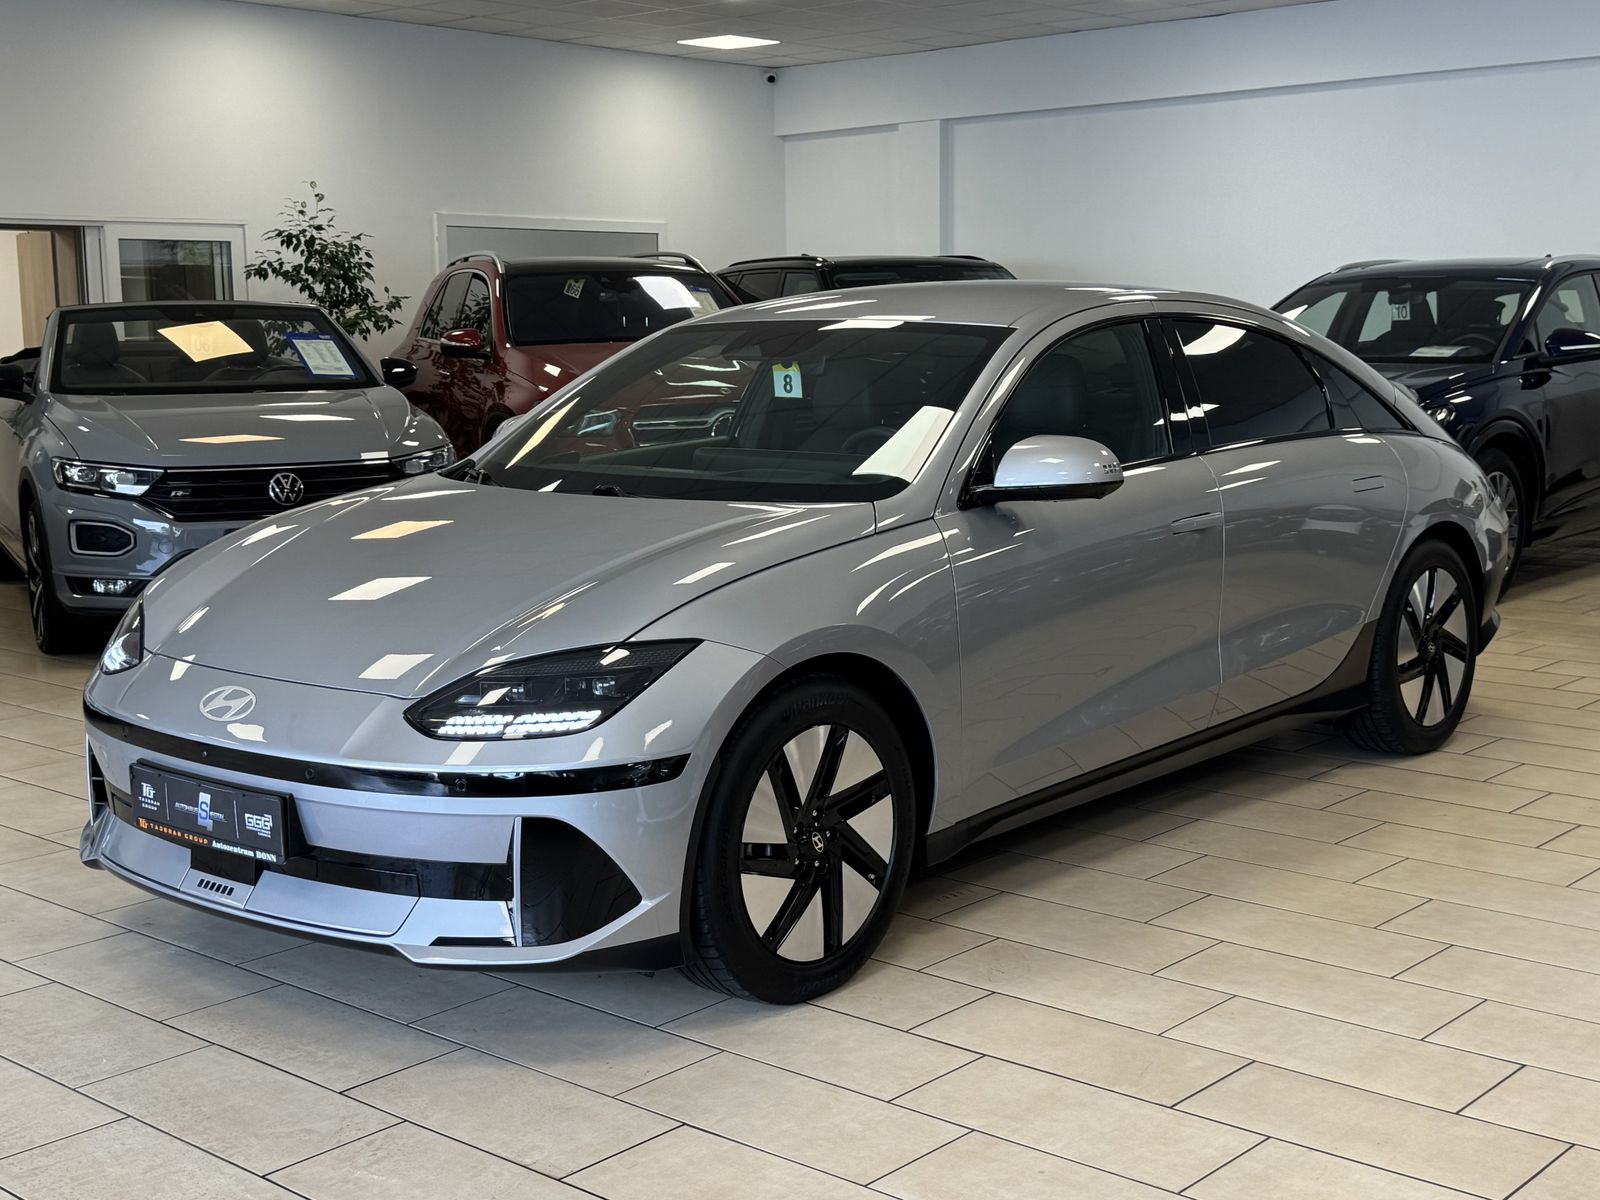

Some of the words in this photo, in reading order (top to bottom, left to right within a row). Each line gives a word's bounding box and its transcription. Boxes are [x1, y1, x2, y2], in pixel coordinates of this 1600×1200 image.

[1395, 305, 1407, 319] 10
[783, 374, 793, 394] 8
[211, 839, 254, 857] Autozentrum
[256, 850, 277, 863] BONN
